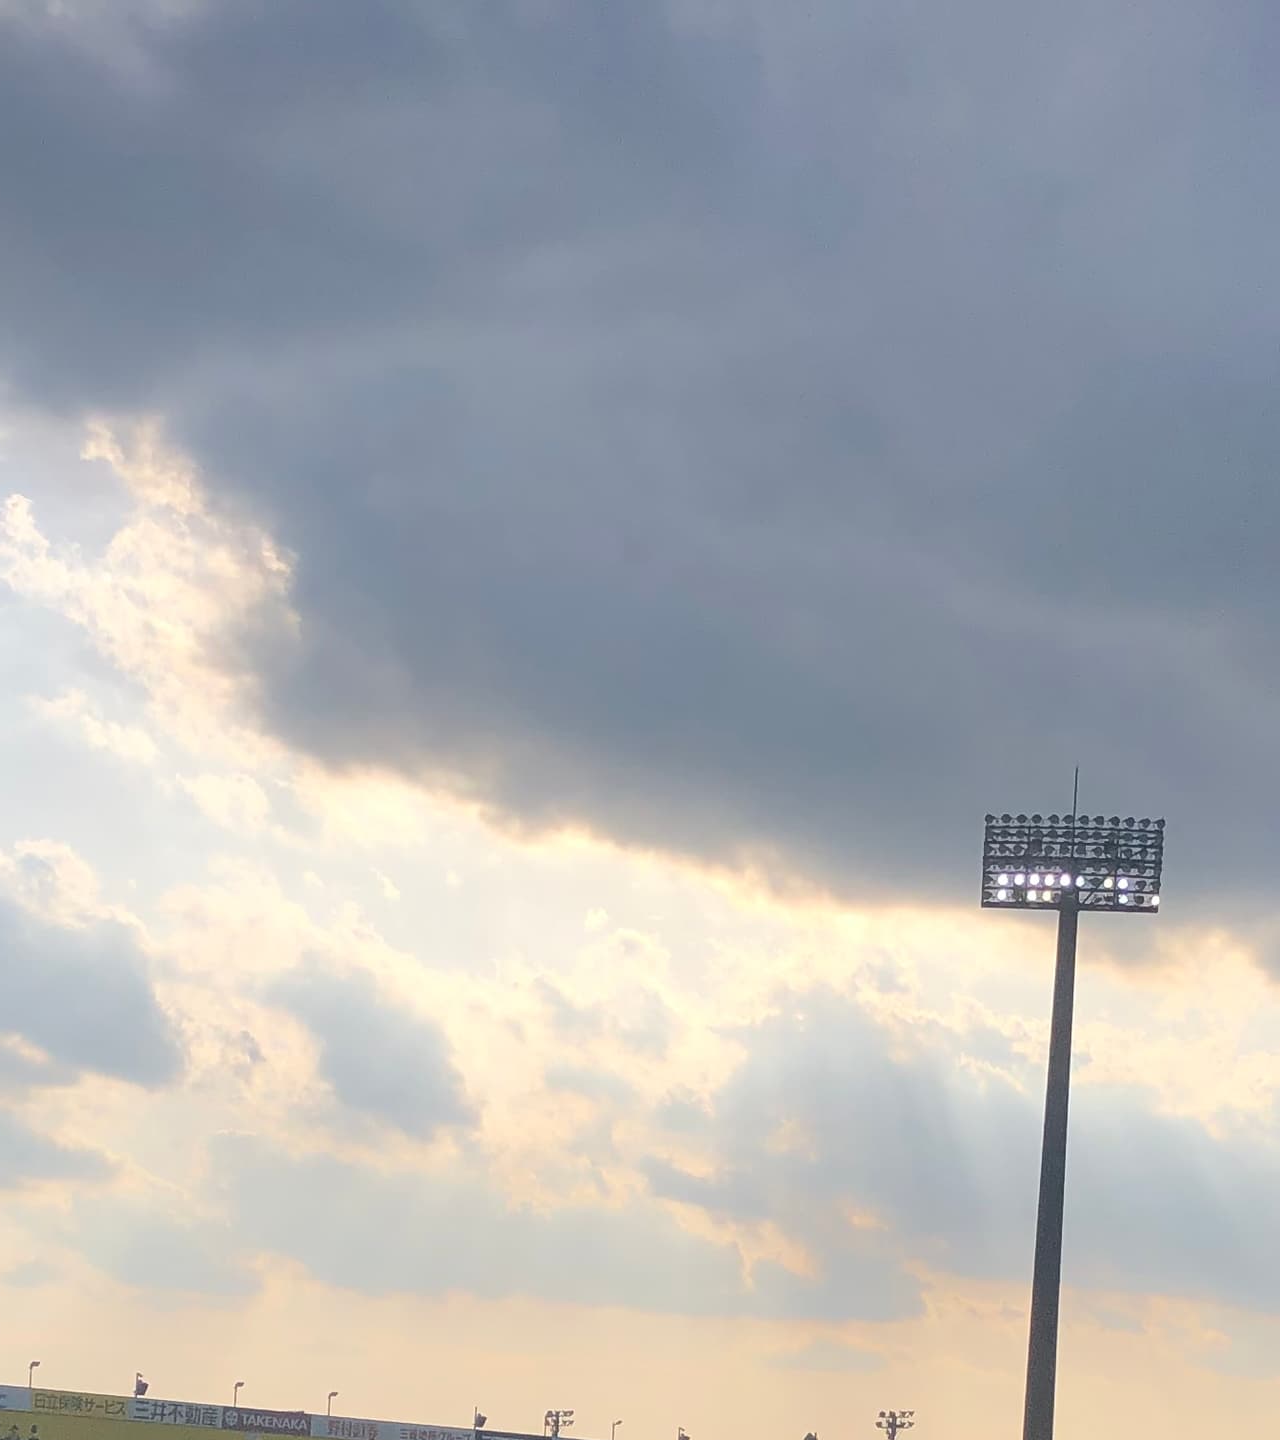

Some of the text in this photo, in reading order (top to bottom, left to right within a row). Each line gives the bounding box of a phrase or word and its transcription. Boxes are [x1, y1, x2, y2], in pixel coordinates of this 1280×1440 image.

[133, 1399, 219, 1426] 三井不動産
[241, 1413, 308, 1431] TAKENAKA
